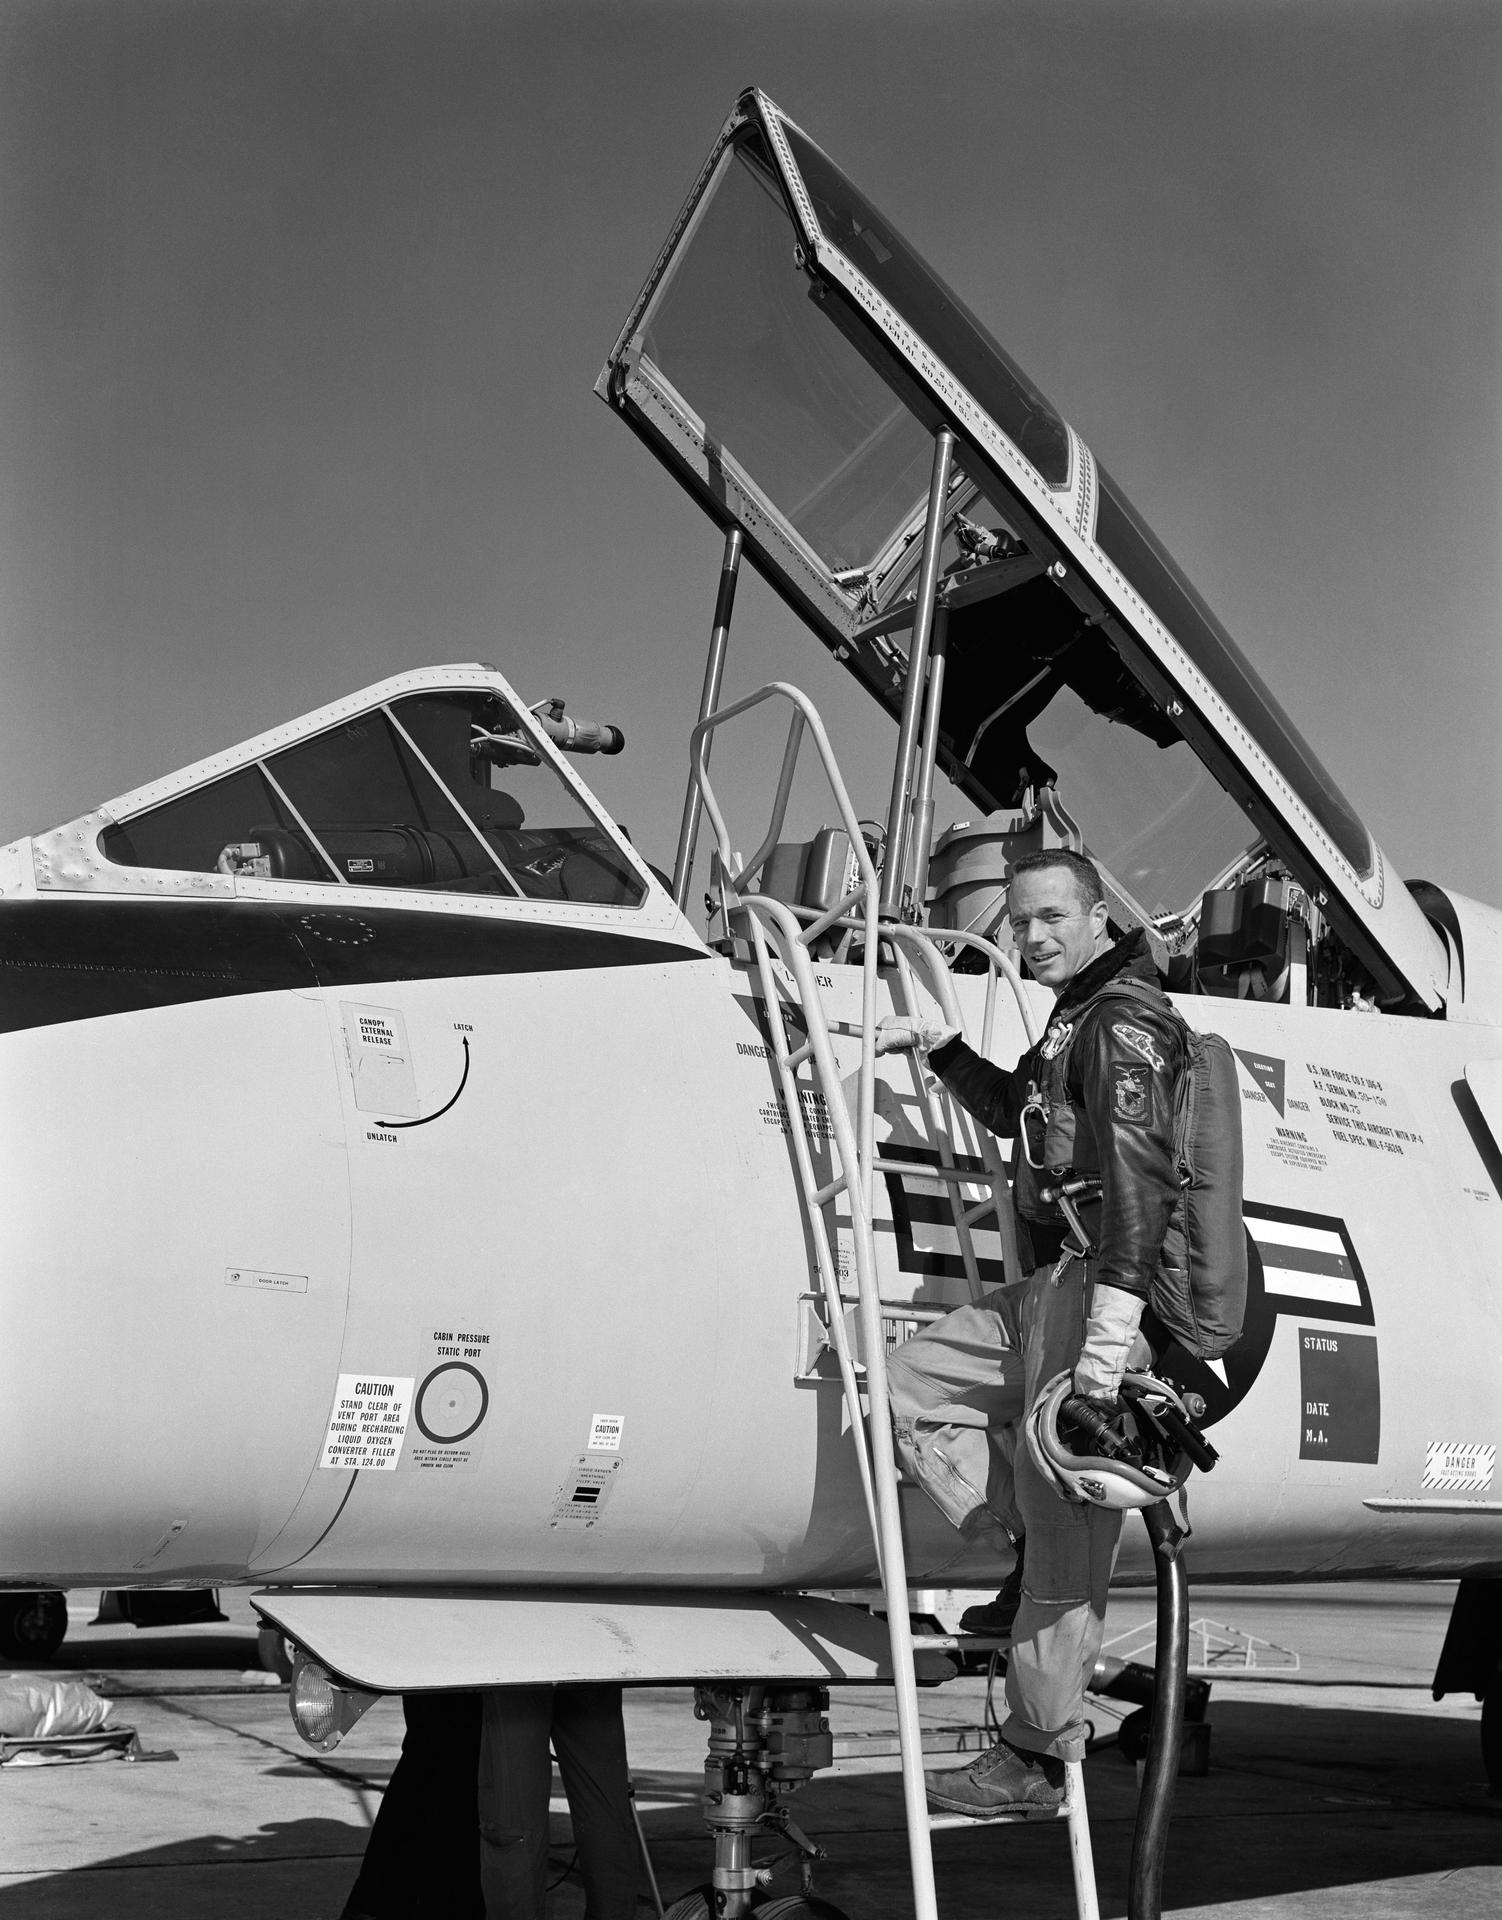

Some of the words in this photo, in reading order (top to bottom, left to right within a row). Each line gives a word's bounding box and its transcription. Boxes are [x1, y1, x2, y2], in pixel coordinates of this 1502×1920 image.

[360, 1018, 384, 1028] CANOPY
[454, 1023, 474, 1032] LATCH
[360, 1026, 394, 1038] EXTERNAL
[362, 1035, 392, 1046] RELEASE
[736, 1043, 772, 1059] DANGER
[1320, 1067, 1331, 1078] AIR
[1331, 1070, 1351, 1083] FORCE
[1242, 1089, 1267, 1103] DANGER
[1326, 1083, 1347, 1097] SERIAL
[1287, 1098, 1310, 1112] DANGER
[1320, 1096, 1340, 1110] BLOCK
[1326, 1113, 1351, 1128] SERVICE
[1351, 1119, 1367, 1131] THIS
[1367, 1123, 1394, 1137] AIRCRAFT
[1394, 1129, 1410, 1141] WITH
[366, 1132, 398, 1142] UNLATCH
[1275, 1127, 1307, 1142] WARNING
[1332, 1130, 1348, 1142] FUEL
[434, 1331, 453, 1342] CABIN
[457, 1333, 490, 1344] PRESSURE
[1304, 1337, 1338, 1352] STATUS
[437, 1346, 460, 1357] STATIC
[464, 1348, 482, 1358] PORT
[355, 1382, 394, 1397] CAUTION
[340, 1400, 363, 1410] STAND
[368, 1401, 388, 1411] CLEAR
[393, 1403, 402, 1411] OF
[1306, 1402, 1330, 1416] DATE
[337, 1411, 355, 1420] VENT
[360, 1413, 378, 1422] PORT
[383, 1414, 400, 1422] AREA
[331, 1423, 357, 1432] DURING
[361, 1424, 405, 1435] RECHARGING
[595, 1425, 620, 1434] CAUTION
[338, 1435, 362, 1444] LIQUID
[367, 1436, 392, 1445] OXYGEN
[1306, 1429, 1328, 1443] M.A.
[328, 1446, 368, 1456] CONVERTER
[372, 1447, 396, 1456] FILLER
[330, 1457, 339, 1465] AT
[344, 1458, 359, 1466] STA.
[362, 1458, 386, 1466] 124.00
[1446, 1456, 1476, 1468] DANGER
